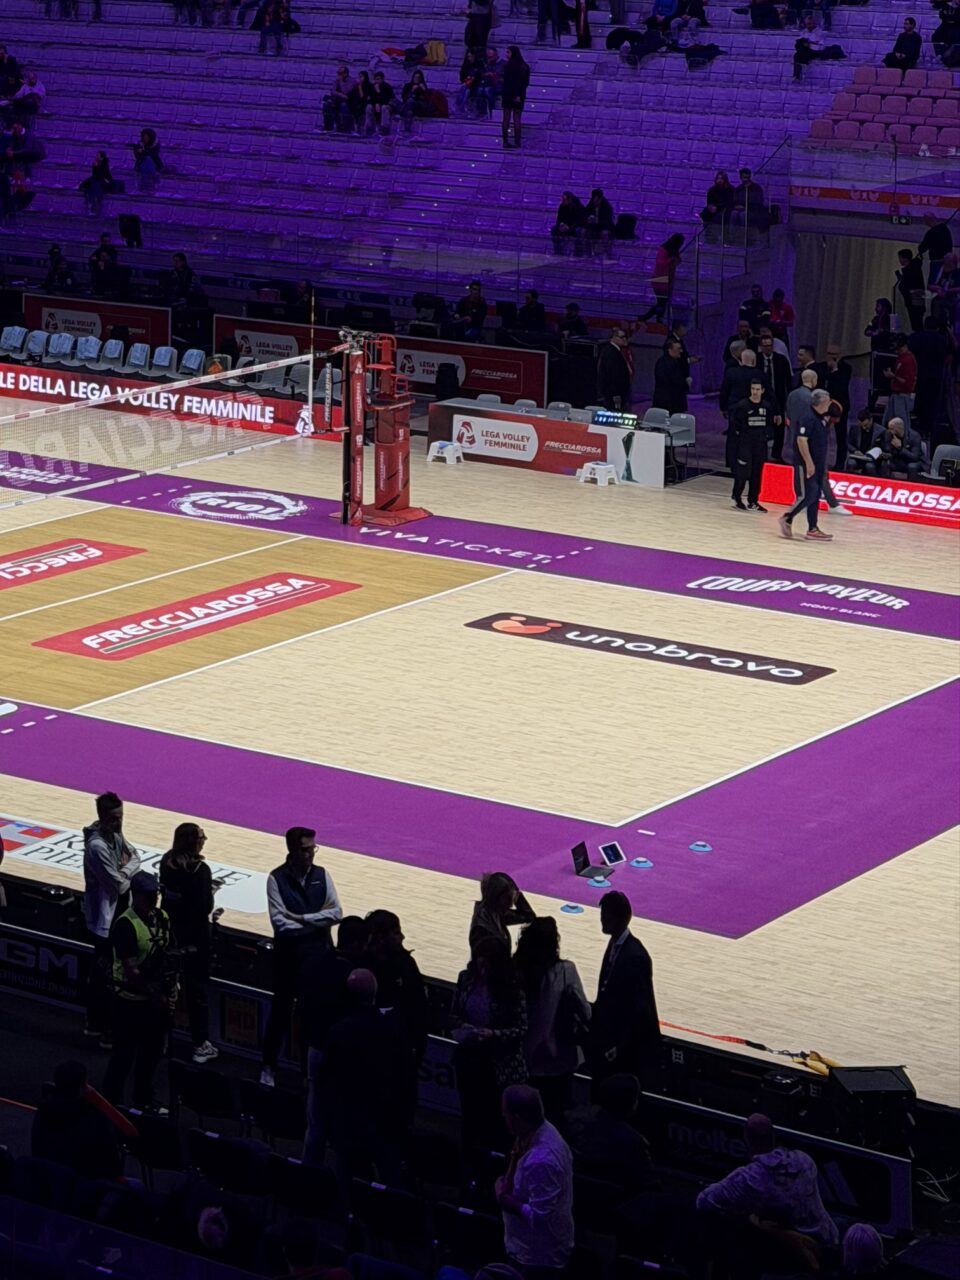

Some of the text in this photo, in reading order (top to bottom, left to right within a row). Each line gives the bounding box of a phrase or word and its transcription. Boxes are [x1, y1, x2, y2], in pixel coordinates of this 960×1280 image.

[471, 369, 517, 379] FRECCIAROSSA
[19, 374, 66, 396] DELLA
[70, 381, 111, 400] LEGA
[117, 386, 179, 410] VOLLEY
[183, 395, 274, 424] FEMMINILE
[481, 430, 531, 443] LEGA VOLLEY
[484, 439, 527, 452] FEMMINILE
[545, 440, 601, 454] FRECCIAROSSA
[828, 479, 960, 511] RECCIAROSSA
[359, 526, 552, 561] VIVATICKET
[686, 575, 911, 610] COURMAYEUR
[81, 578, 316, 648] FRECCIAROSSA
[799, 602, 882, 618] MONT BLANC
[565, 630, 804, 678] unobravo
[666, 1122, 748, 1158] molte
